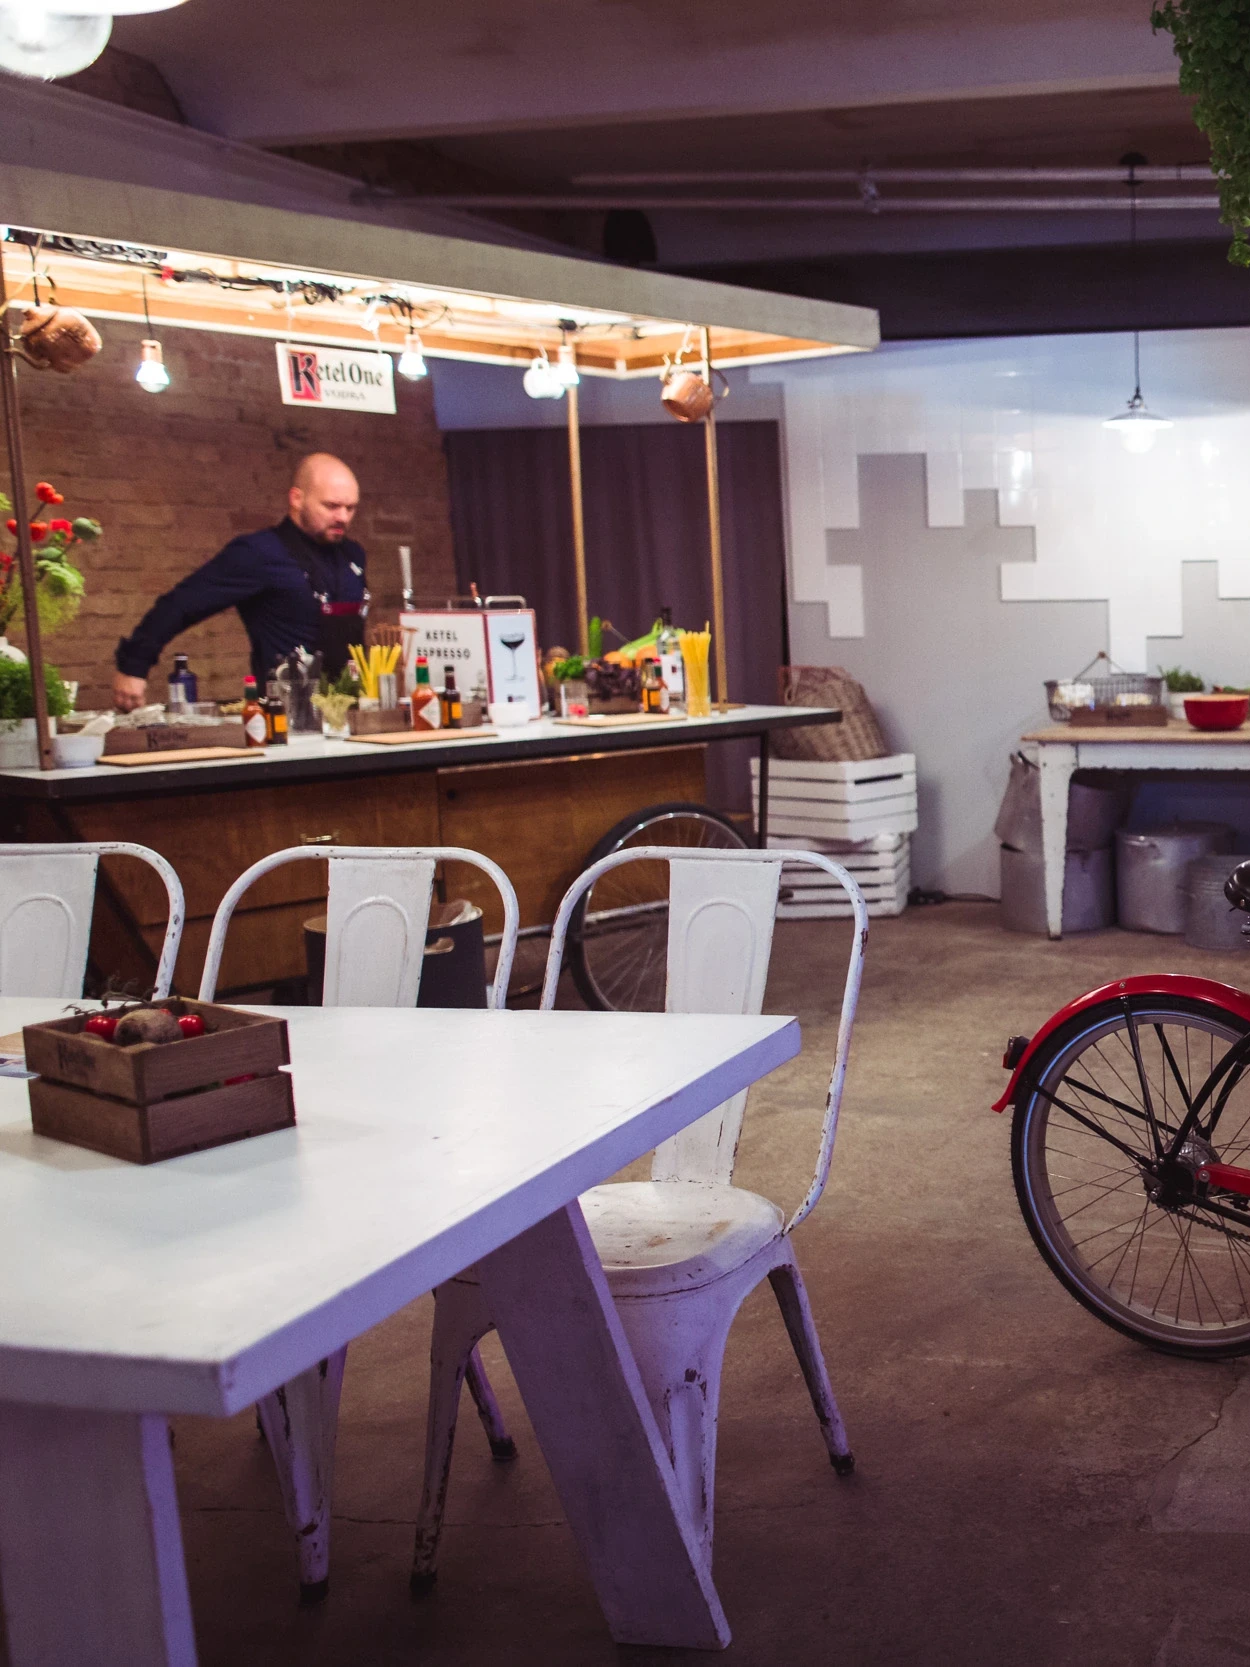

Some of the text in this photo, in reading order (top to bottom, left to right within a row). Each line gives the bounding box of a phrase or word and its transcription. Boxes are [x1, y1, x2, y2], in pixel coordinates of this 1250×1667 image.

[290, 353, 383, 399] Ketel One
[425, 629, 459, 641] KETEL
[416, 647, 472, 660] ESPRESSO
